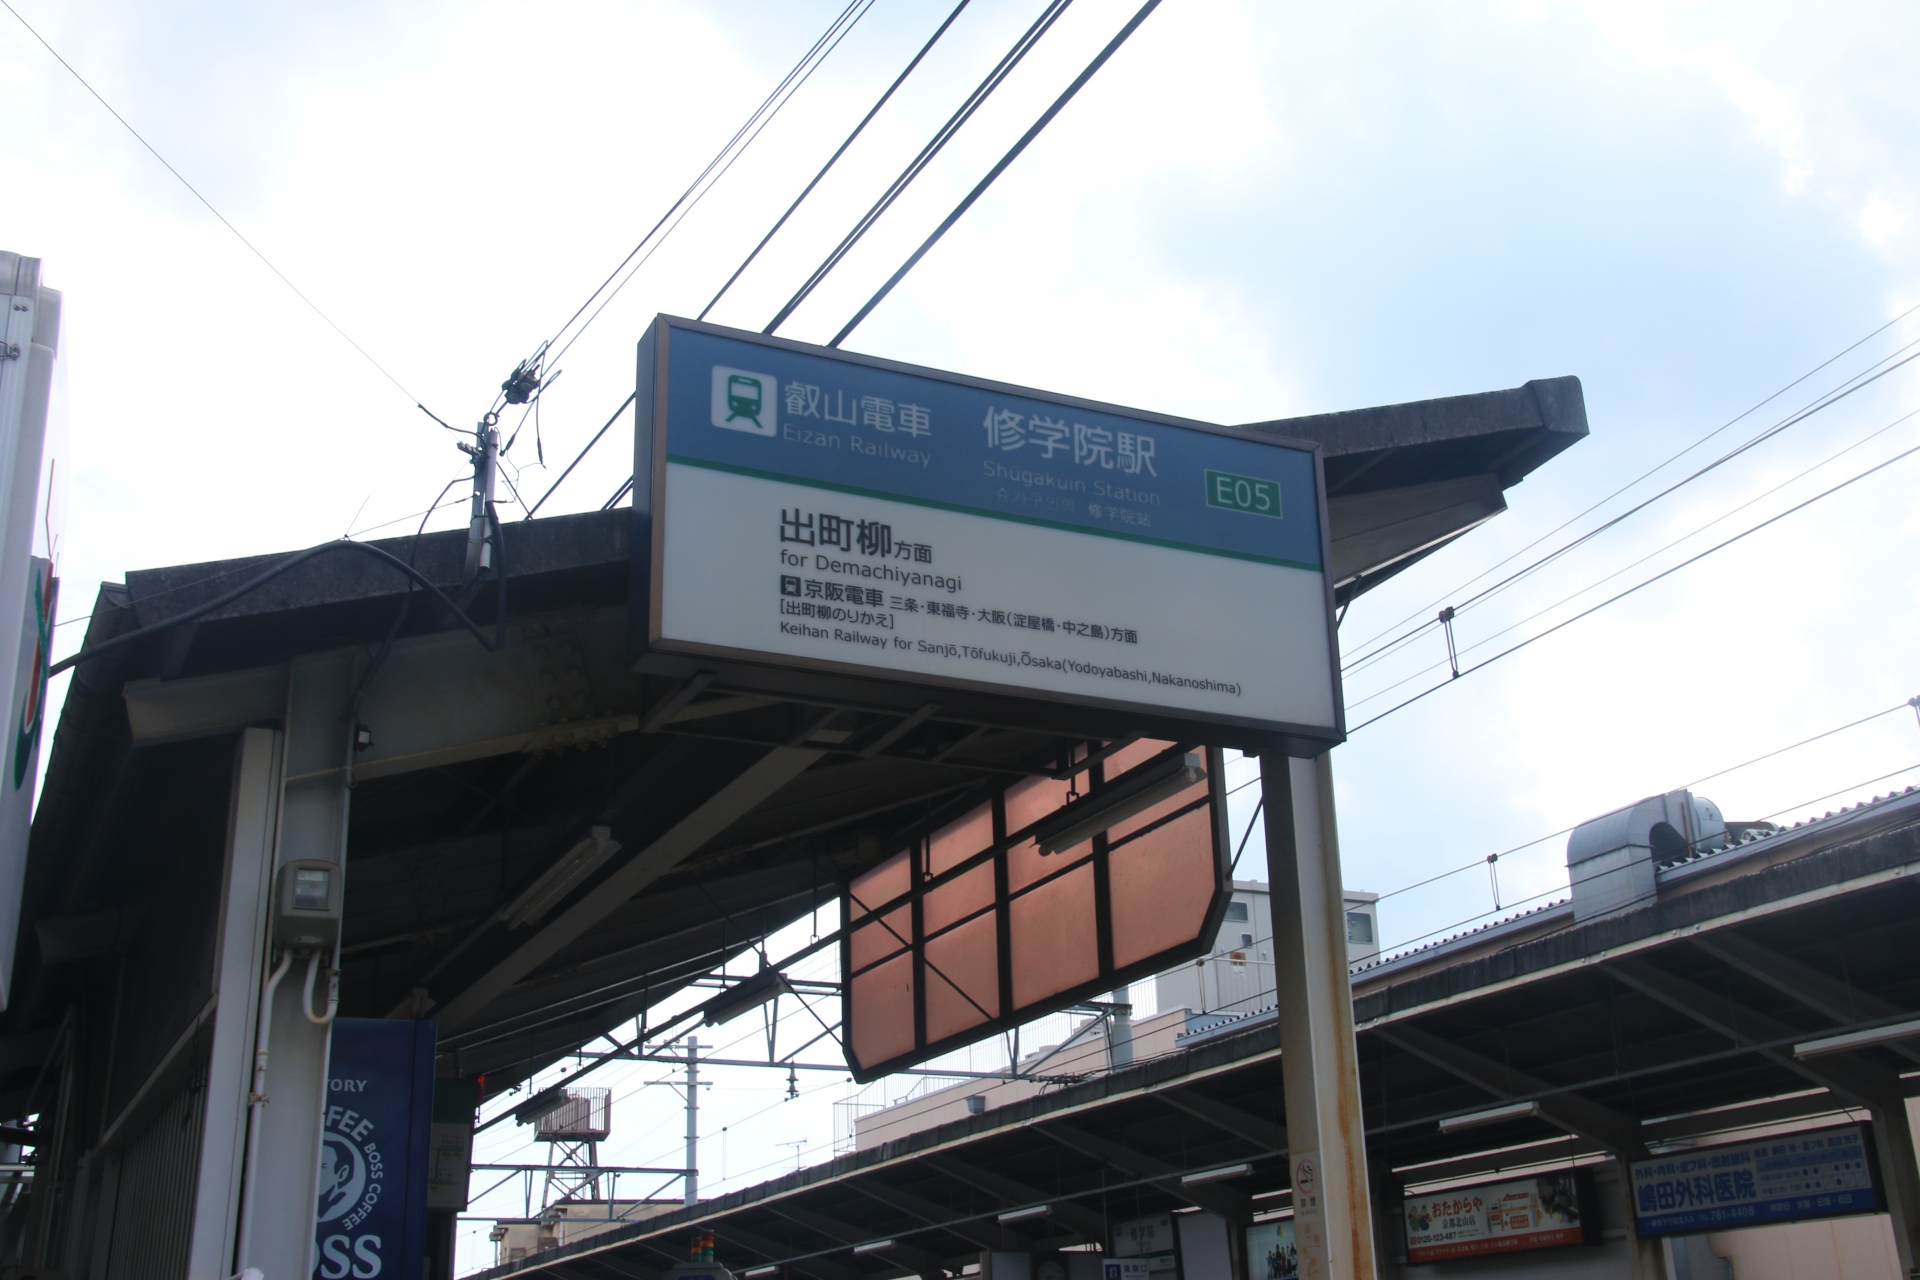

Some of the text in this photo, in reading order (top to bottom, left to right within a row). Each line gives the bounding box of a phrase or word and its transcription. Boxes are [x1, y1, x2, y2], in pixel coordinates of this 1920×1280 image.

[784, 380, 932, 438] 叡山電車
[783, 423, 931, 468] Eizan Railway
[983, 405, 1158, 478] 修学院駅
[983, 460, 1160, 506] Shūgakuin Station
[1216, 476, 1272, 511] E05
[780, 508, 932, 564] 出町柳方面
[1088, 502, 1151, 527] 修学院站
[780, 549, 962, 594] for Demachiyanagi
[803, 579, 885, 608] 京阪電車
[780, 599, 894, 630] [出町柳のりかえ]
[780, 621, 829, 639] Keihan
[834, 628, 888, 650] Railway
[893, 636, 914, 651] for
[341, 1142, 384, 1231] BOSS COFFEE
[1431, 1196, 1484, 1219] おたからや
[1637, 1168, 1758, 1213] 嶋田外科医院
[312, 1234, 382, 1280] SS
